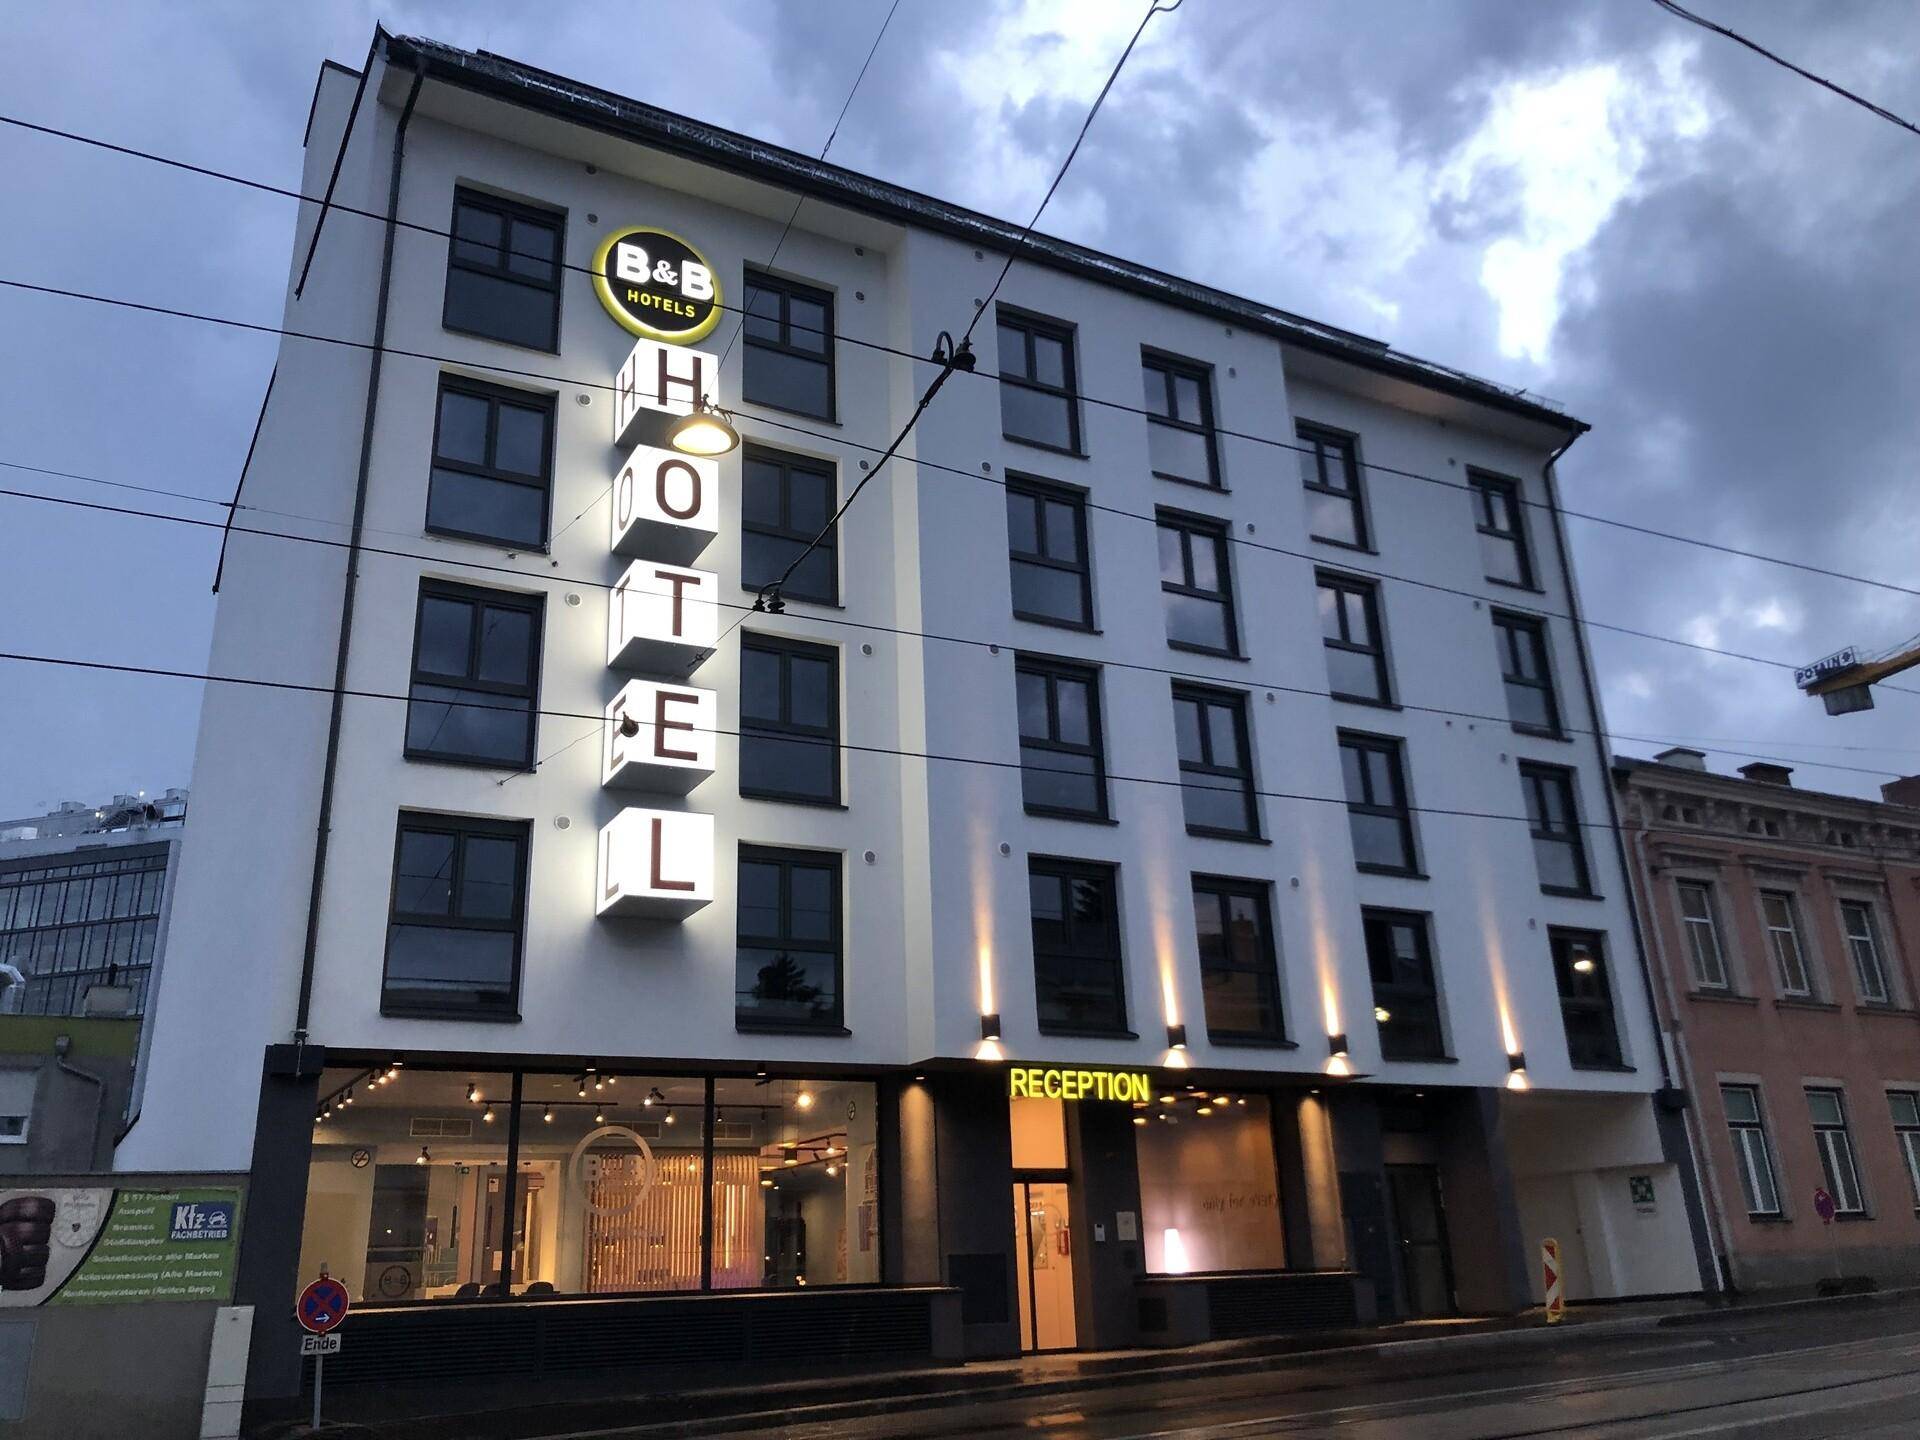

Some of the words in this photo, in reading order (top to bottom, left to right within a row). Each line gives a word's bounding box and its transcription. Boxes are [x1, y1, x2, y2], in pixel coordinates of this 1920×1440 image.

[616, 241, 714, 301] B&B
[627, 289, 696, 318] HOTELS
[650, 347, 702, 892] HOTEL
[1010, 1067, 1149, 1102] RECEPTION
[174, 1204, 206, 1230] Kfz
[171, 1229, 228, 1239] FACHBETRIEB
[304, 1337, 337, 1351] Ende
